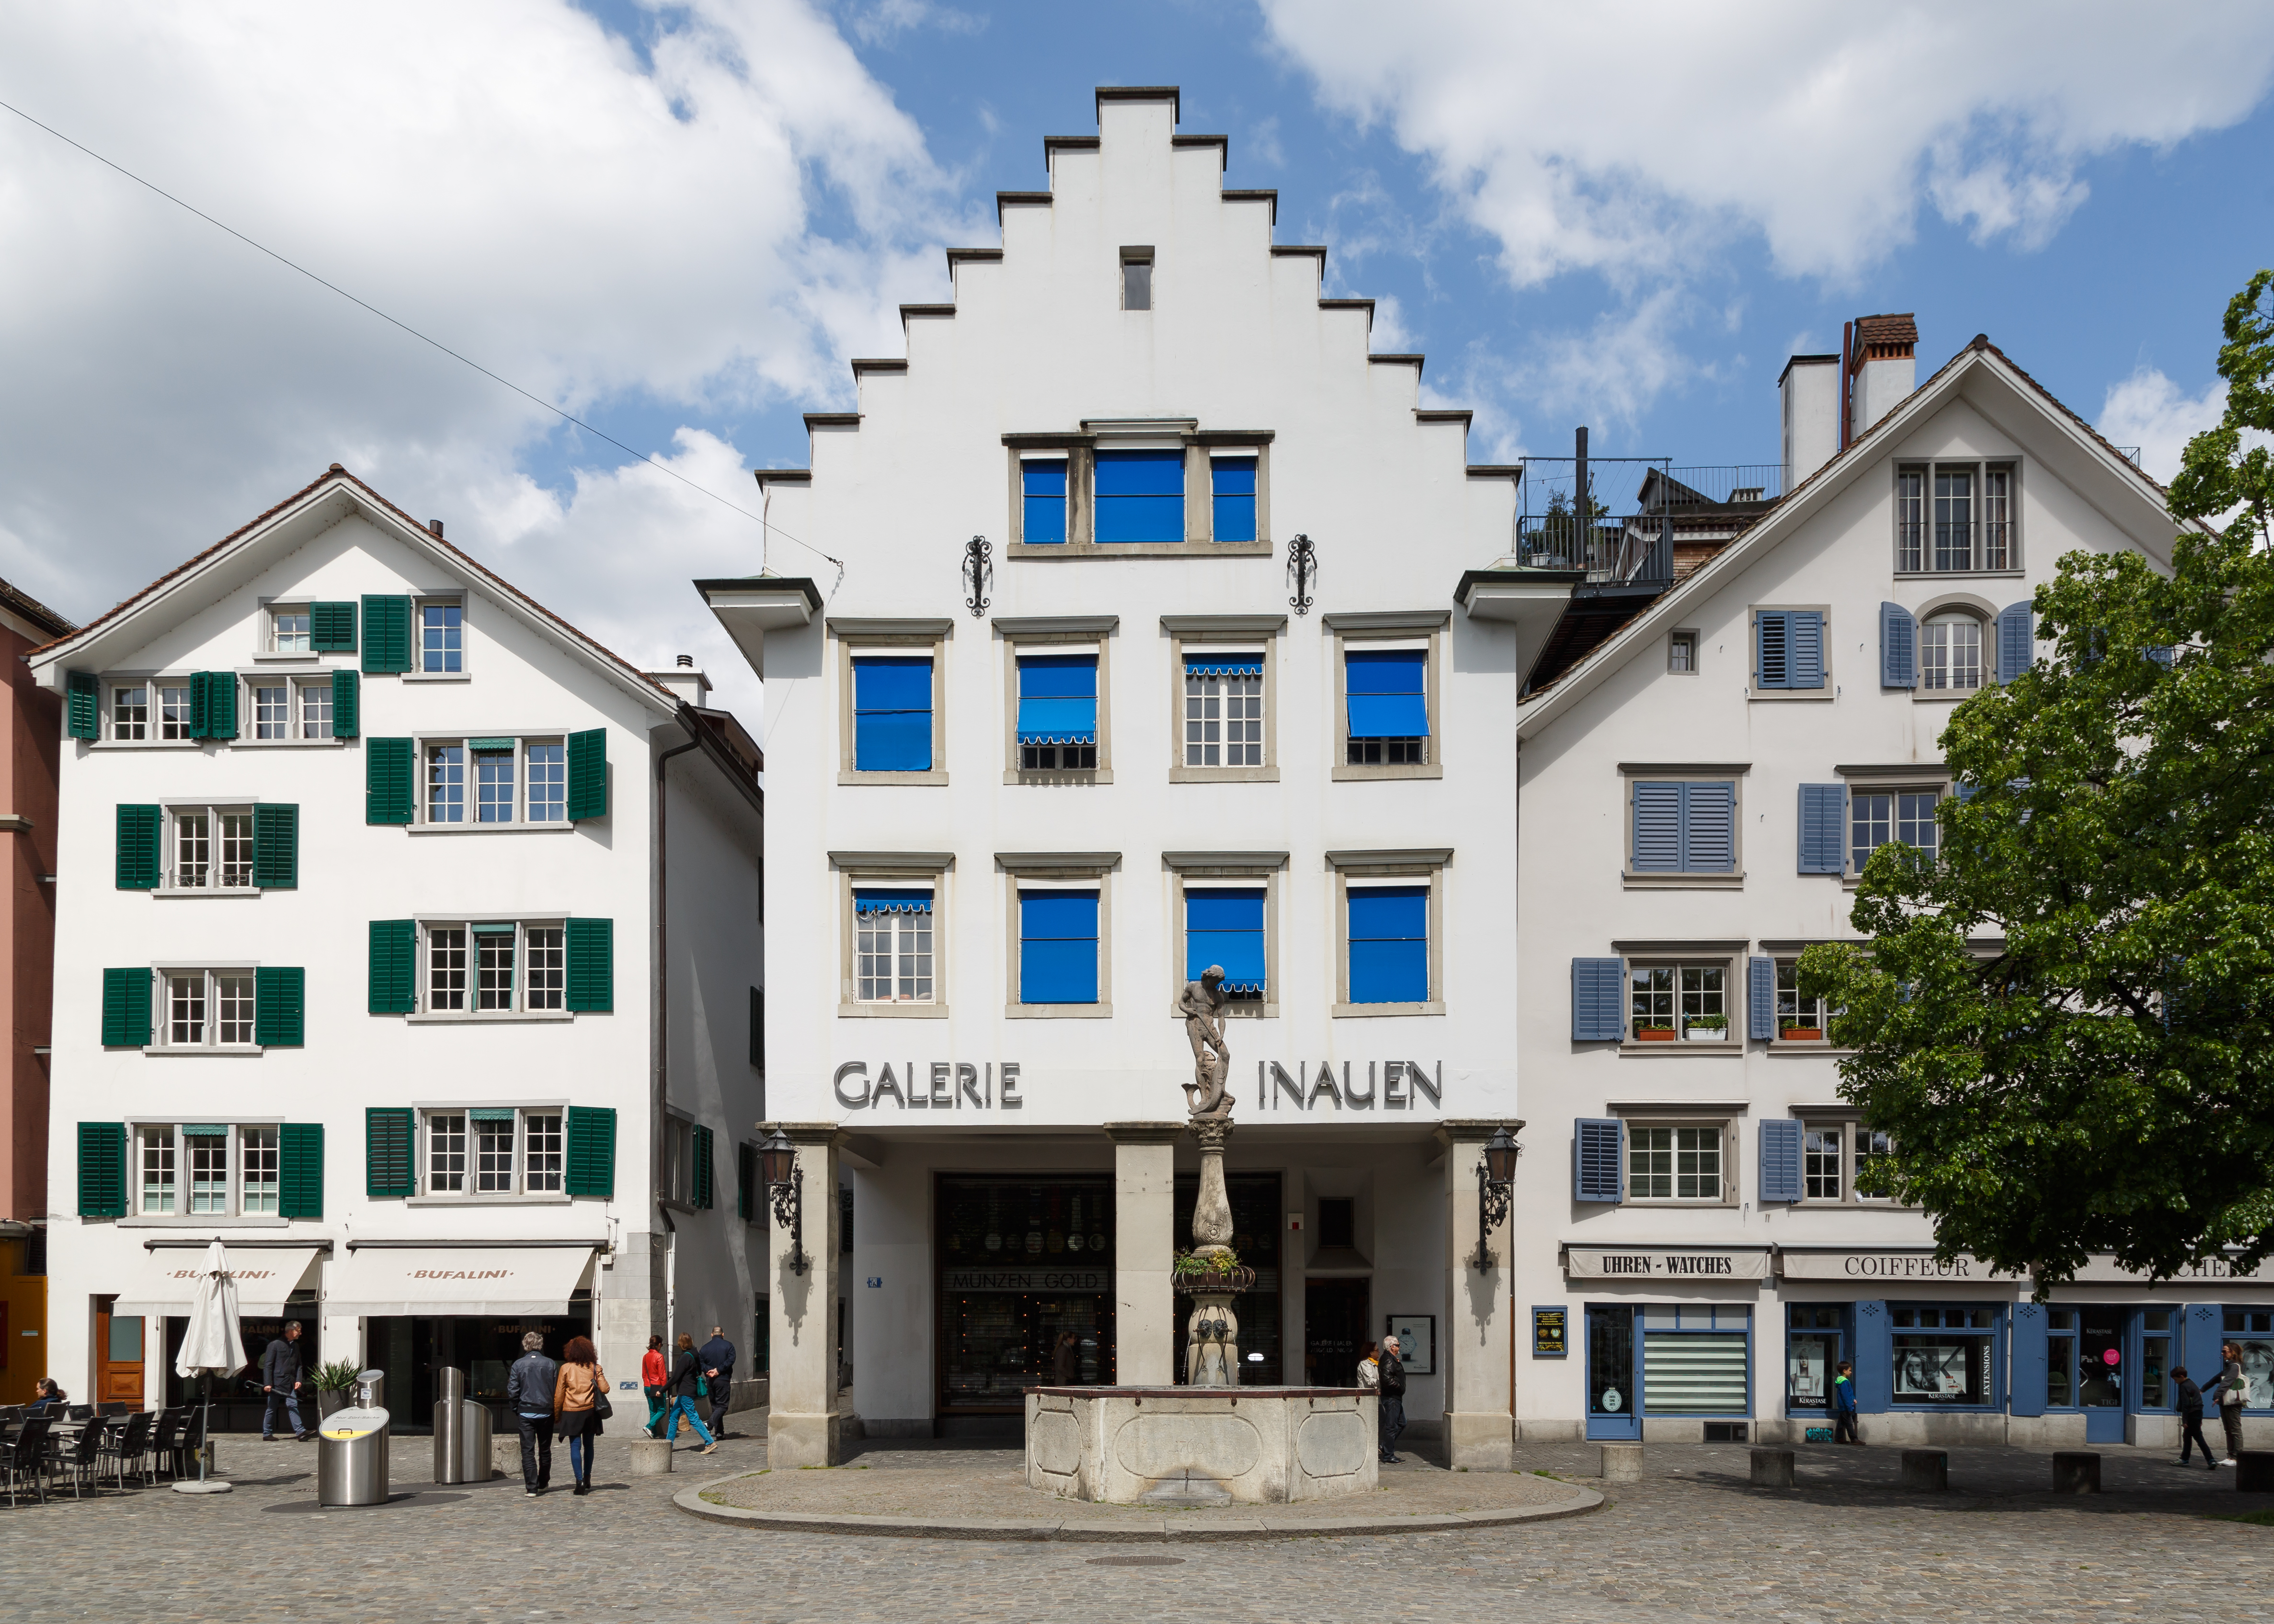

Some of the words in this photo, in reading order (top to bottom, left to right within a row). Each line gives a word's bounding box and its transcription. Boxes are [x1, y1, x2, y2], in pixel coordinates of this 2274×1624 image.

[833, 1060, 1023, 1101] GALERIE
[1258, 1060, 1442, 1101] INAUEN
[1602, 1256, 1652, 1273] UHREN
[1666, 1256, 1732, 1274] WATCHES
[1844, 1257, 1970, 1277] COIFFEUR
[173, 1270, 270, 1279] BULINI
[413, 1270, 508, 1279] BUFALINI
[1044, 1273, 1098, 1289] GOLD
[242, 1325, 280, 1334] FALINI
[498, 1325, 551, 1333] BUFALINI
